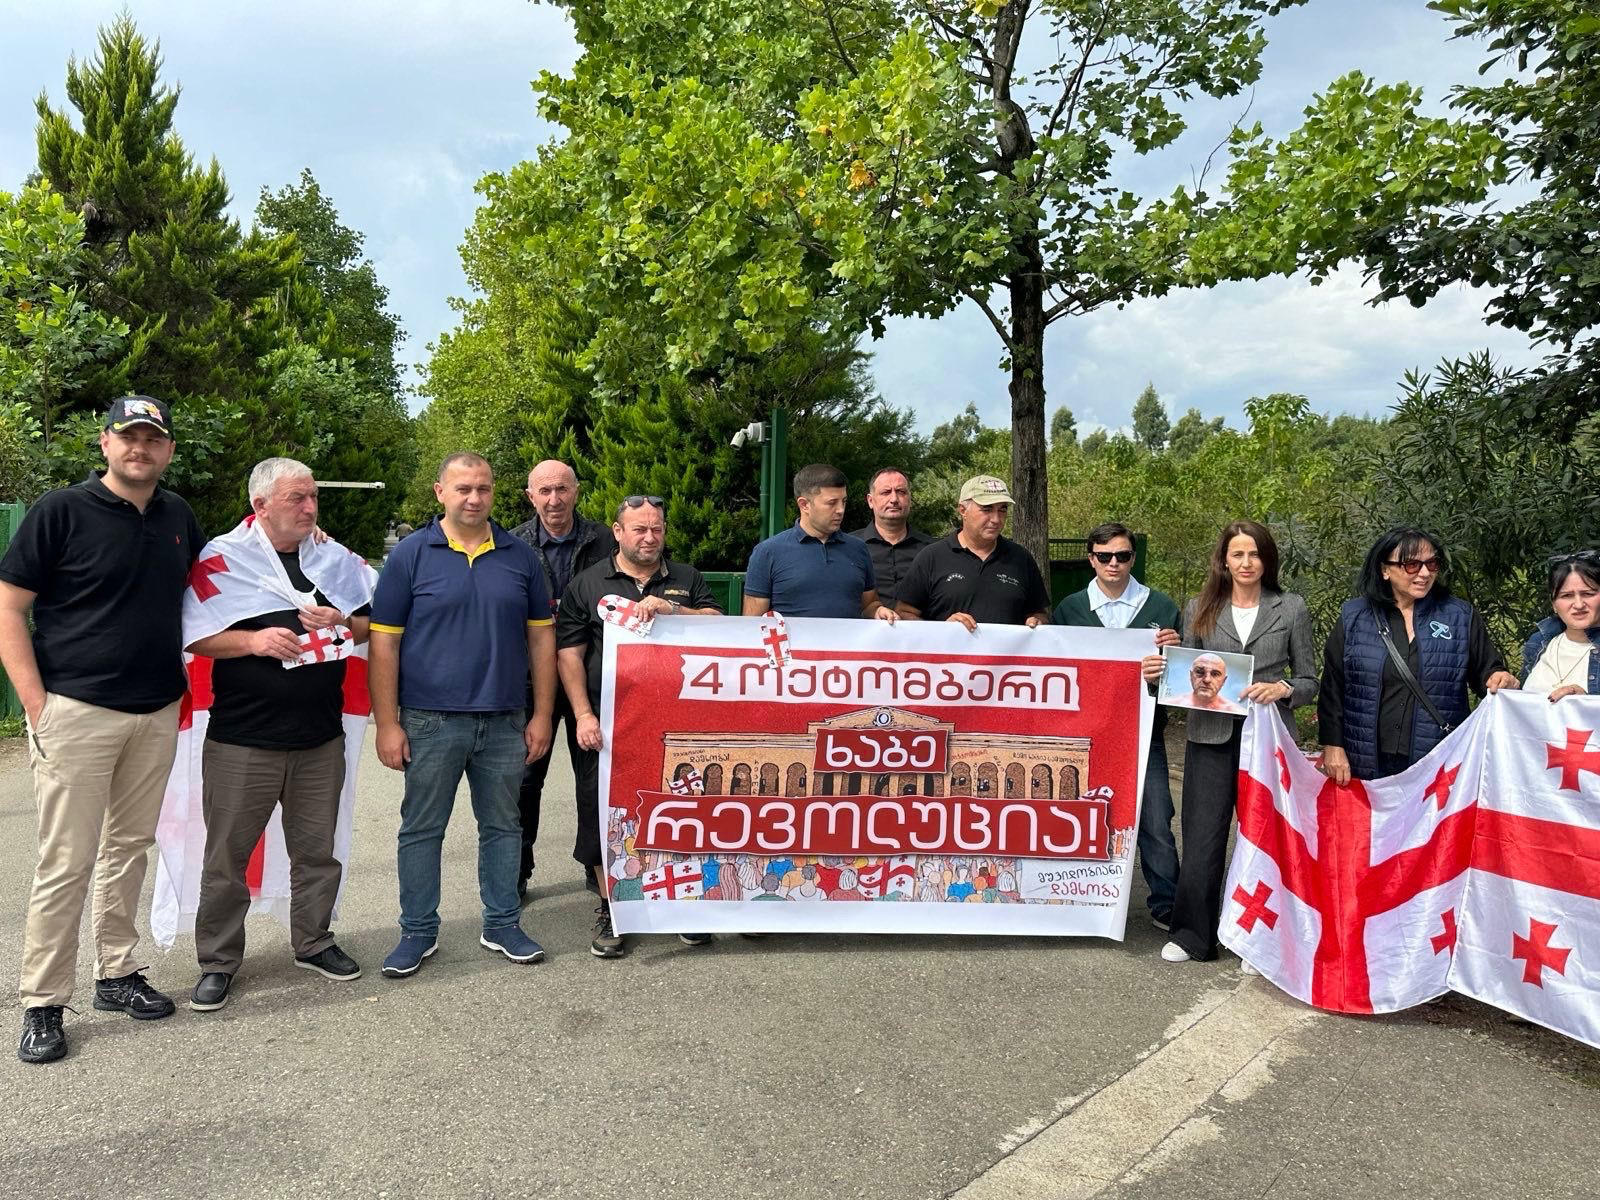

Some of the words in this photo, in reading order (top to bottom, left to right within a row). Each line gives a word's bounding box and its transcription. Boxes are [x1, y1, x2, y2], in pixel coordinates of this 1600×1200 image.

[690, 662, 723, 695] 4
[739, 663, 1071, 704] ოქტომბერი
[826, 734, 937, 768] ხაბე
[646, 801, 1098, 854] რევოლუცია!
[1050, 882, 1120, 898] დამხობა
